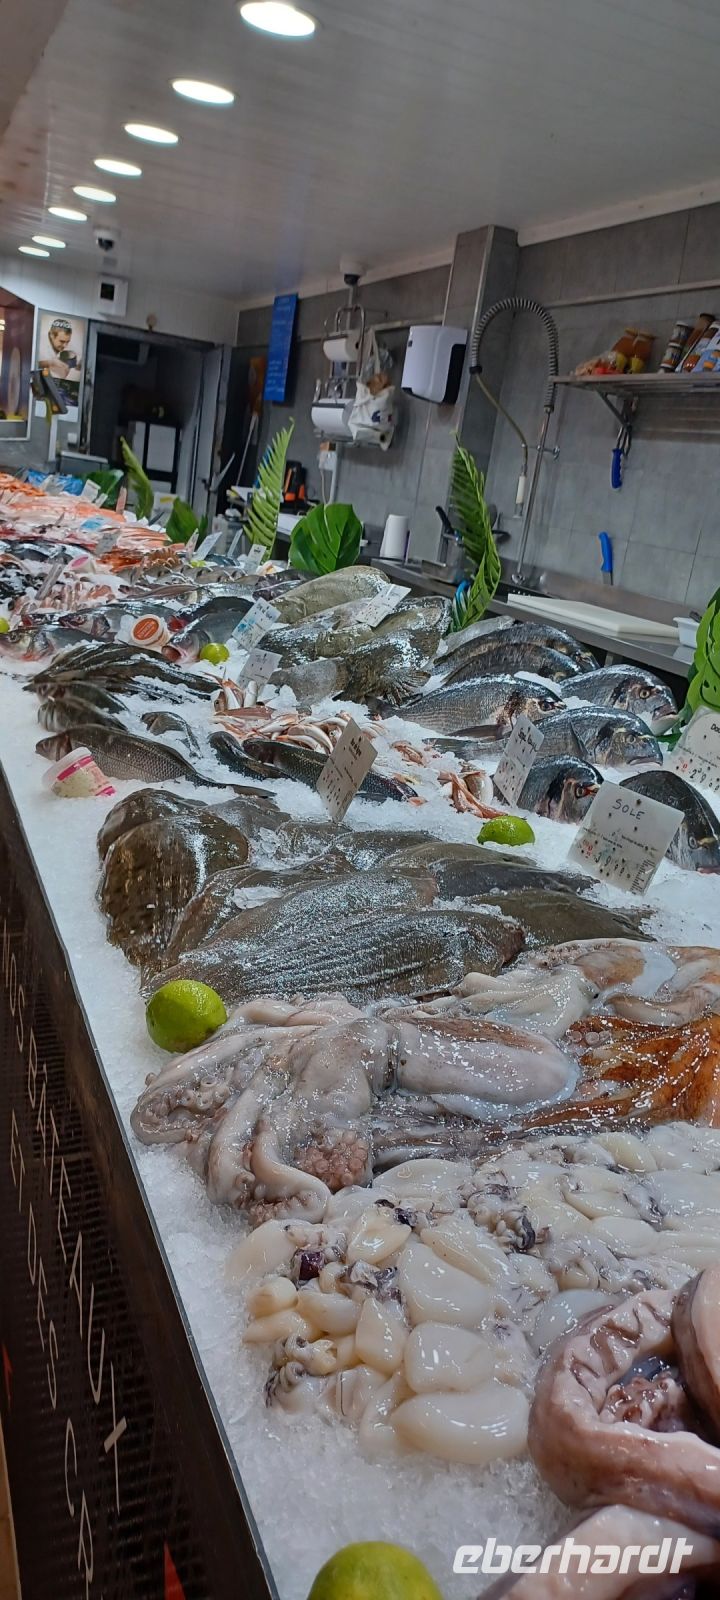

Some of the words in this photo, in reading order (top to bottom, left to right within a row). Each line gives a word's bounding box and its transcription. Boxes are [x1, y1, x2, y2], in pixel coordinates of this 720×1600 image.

[612, 798, 645, 820] SOLE
[2, 918, 25, 1052] NOS
[10, 1108, 26, 1212] ET
[28, 1202, 58, 1410] DES
[65, 1417, 103, 1600] CR
